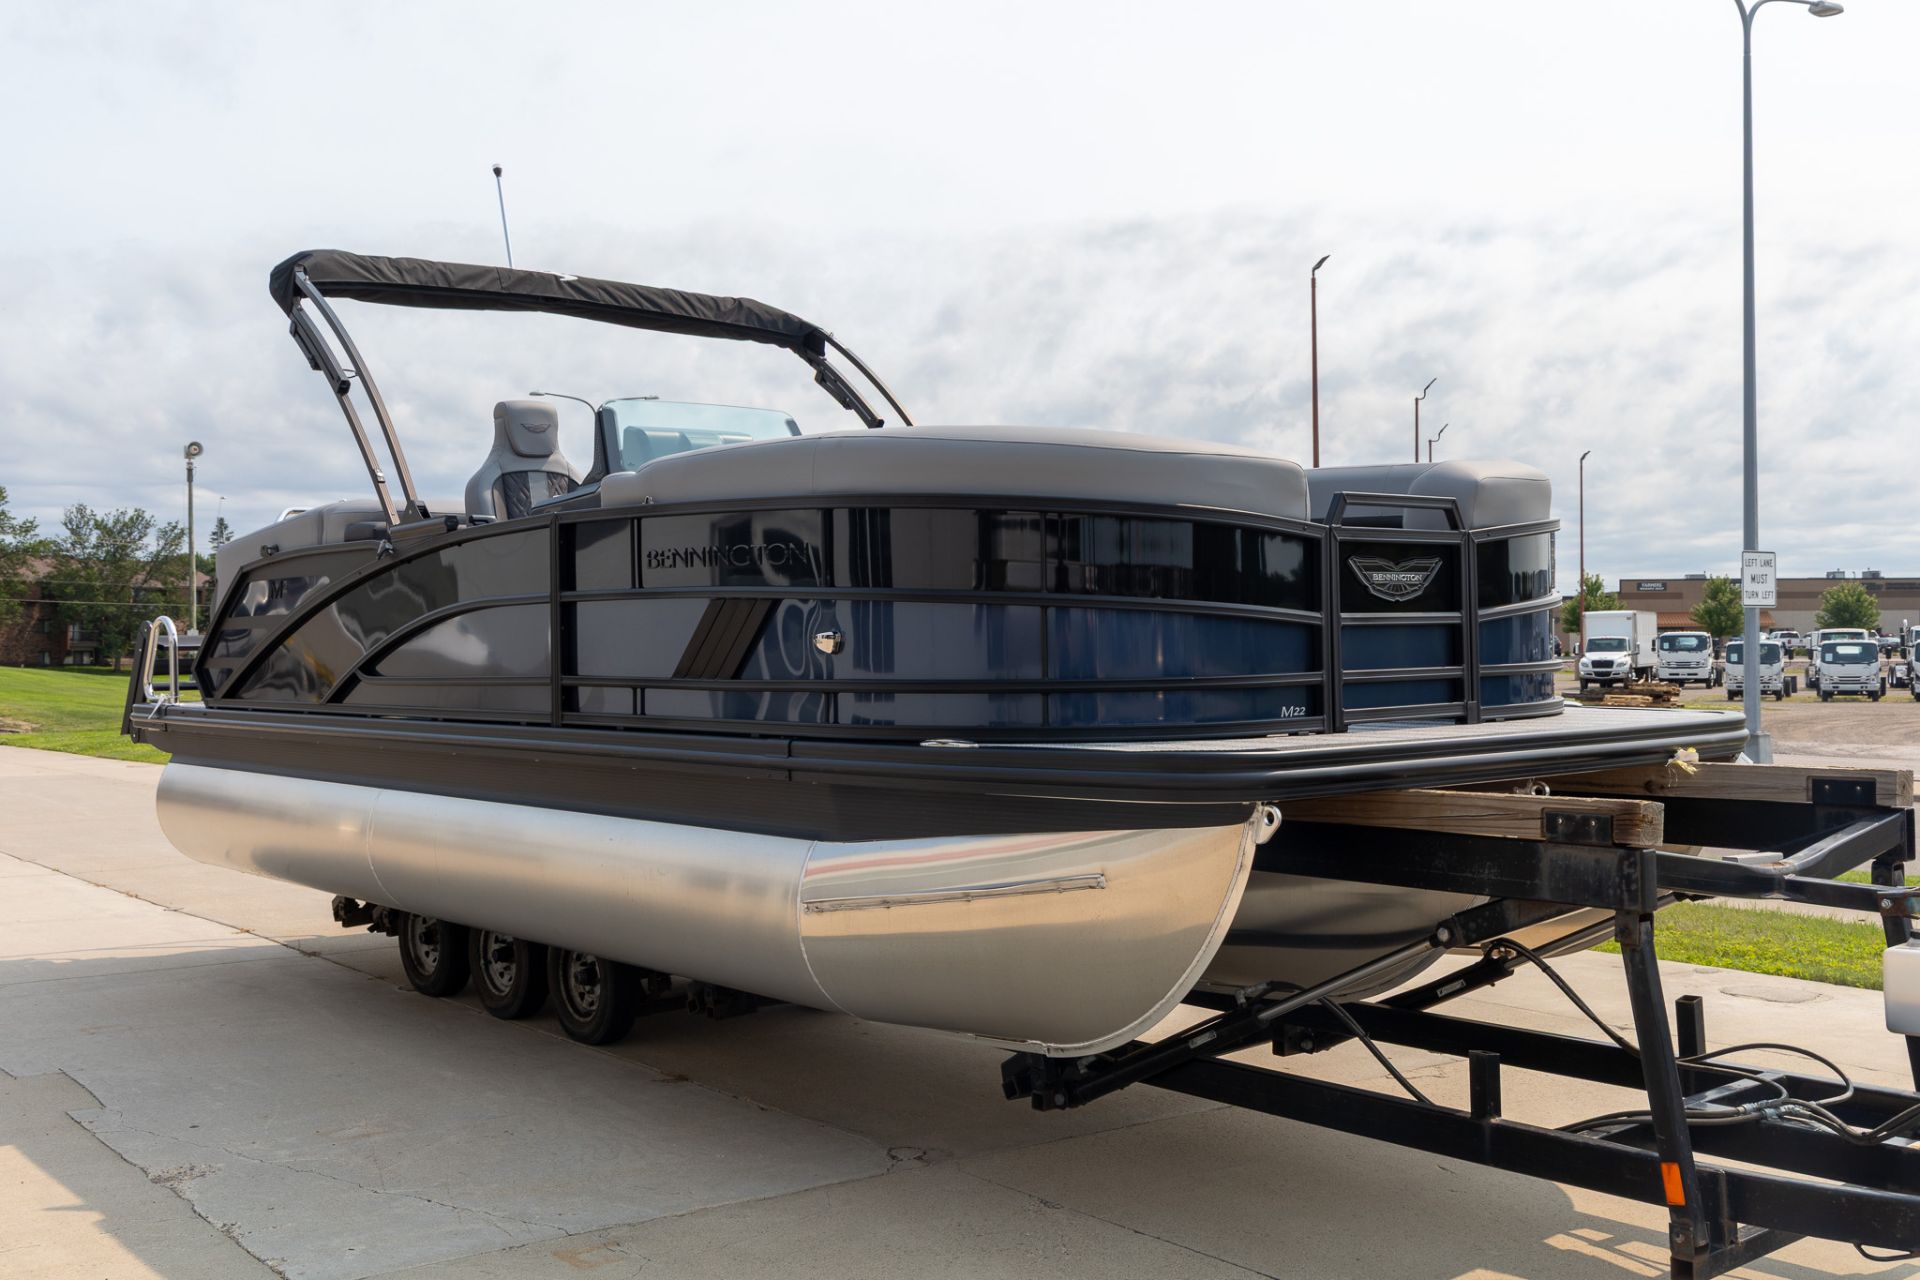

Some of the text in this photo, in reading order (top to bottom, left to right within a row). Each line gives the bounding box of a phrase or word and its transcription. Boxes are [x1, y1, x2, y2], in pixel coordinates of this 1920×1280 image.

[647, 543, 809, 569] BENNINGTON
[1745, 558, 1773, 568] LEFT LANE
[1372, 573, 1422, 581] BENNINGTON
[1750, 573, 1768, 584] MUST
[1745, 590, 1774, 599] TURN LEFT
[1281, 705, 1306, 718] M22
